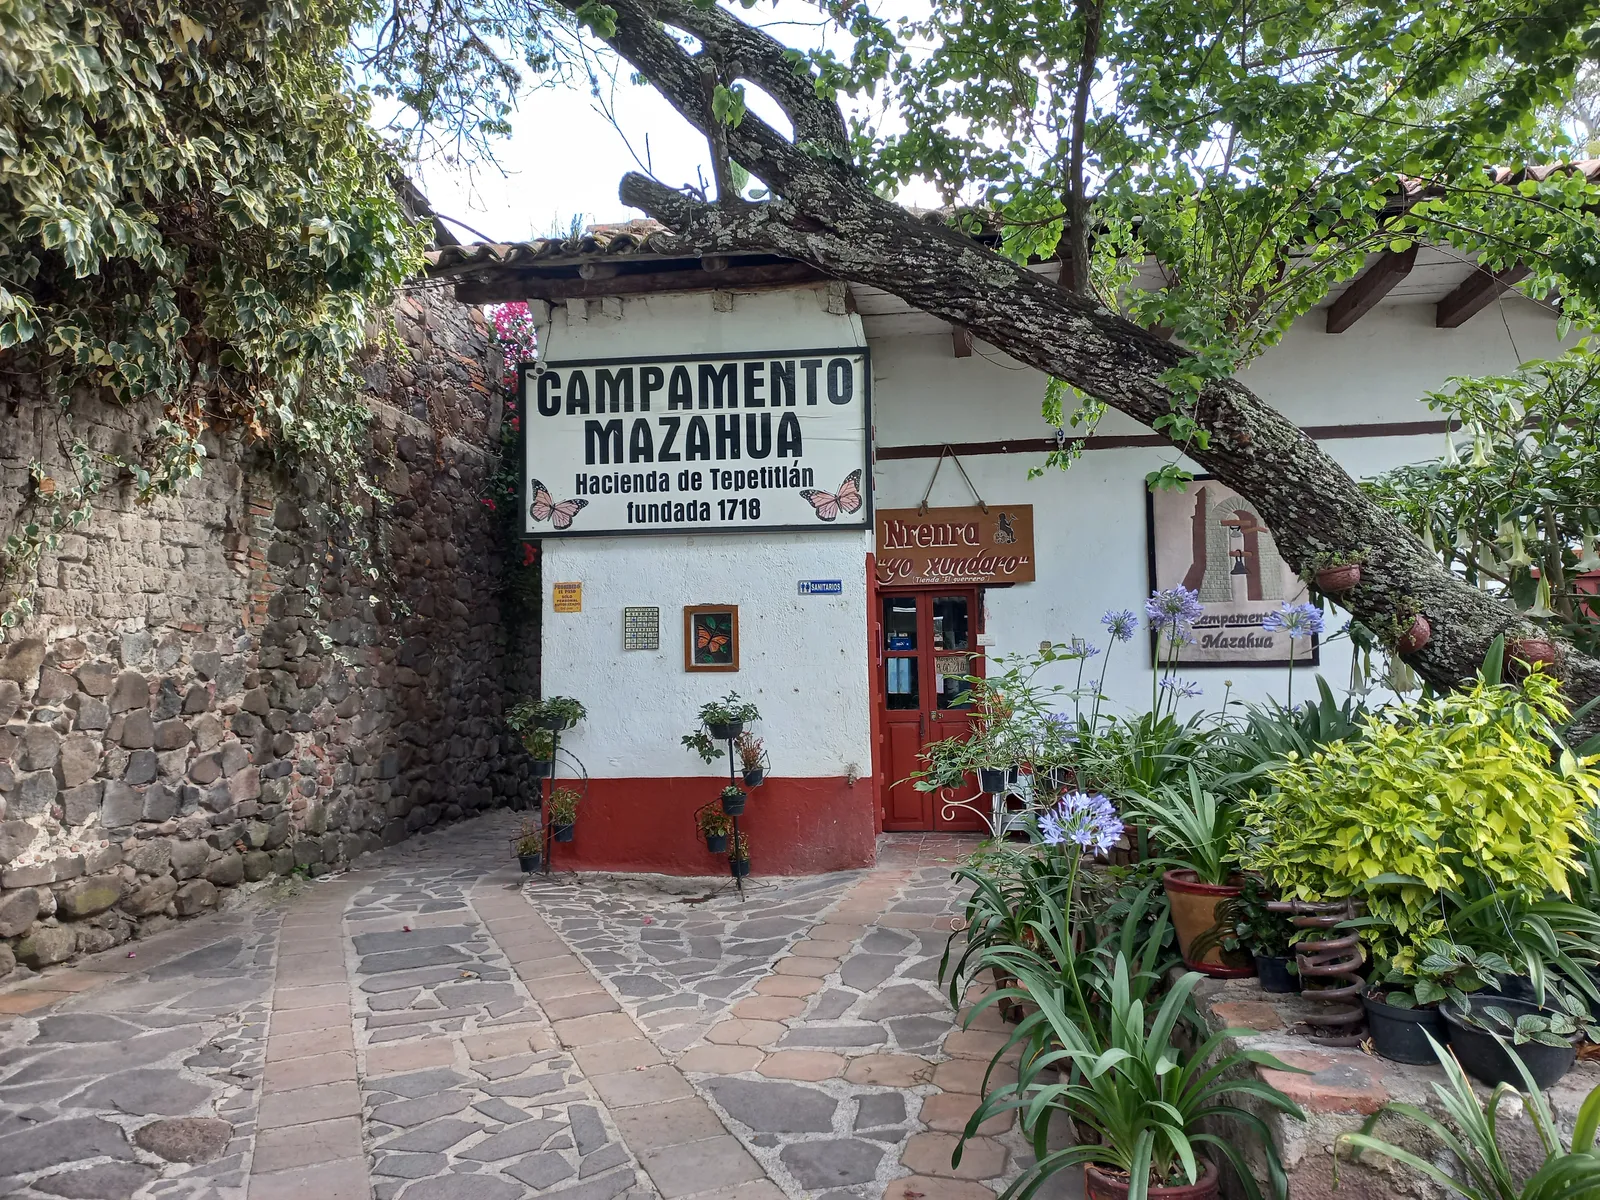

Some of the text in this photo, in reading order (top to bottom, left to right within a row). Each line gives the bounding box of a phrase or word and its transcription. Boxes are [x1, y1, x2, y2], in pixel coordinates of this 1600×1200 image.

[537, 357, 854, 417] CAMPAMENTO
[584, 411, 803, 465] MAZAHUA
[575, 460, 814, 495] Hacienda de Tepetitlán
[627, 497, 761, 524] fundada 1718
[883, 520, 980, 549] Nrenra
[811, 583, 841, 591] SANITARIOS
[1201, 631, 1274, 649] Mazahua
